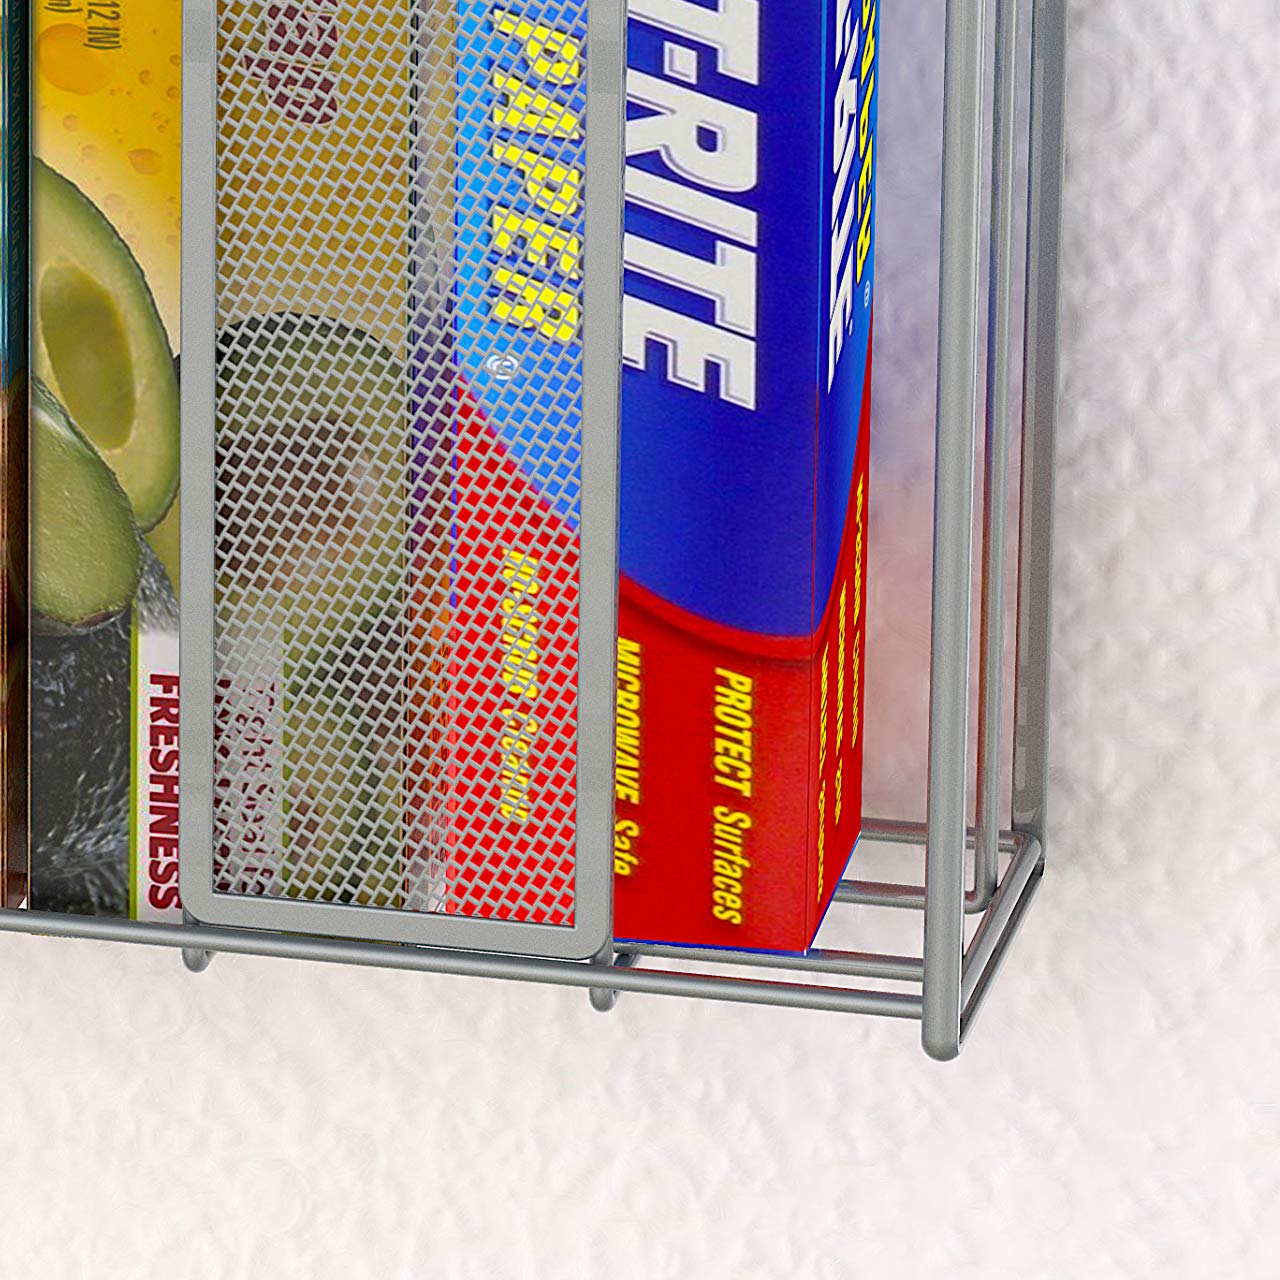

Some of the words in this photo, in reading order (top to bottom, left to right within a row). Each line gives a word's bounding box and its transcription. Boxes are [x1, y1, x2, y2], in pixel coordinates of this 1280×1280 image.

[83, 24, 123, 50] IN)
[88, 1, 122, 20] 12
[491, 7, 582, 343] PAPER
[616, 636, 642, 805] MICROWAVE
[715, 667, 753, 798] PROTECT
[149, 674, 183, 910] FRESHNESS
[615, 814, 640, 876] Safe
[712, 805, 752, 925] Surfaces
